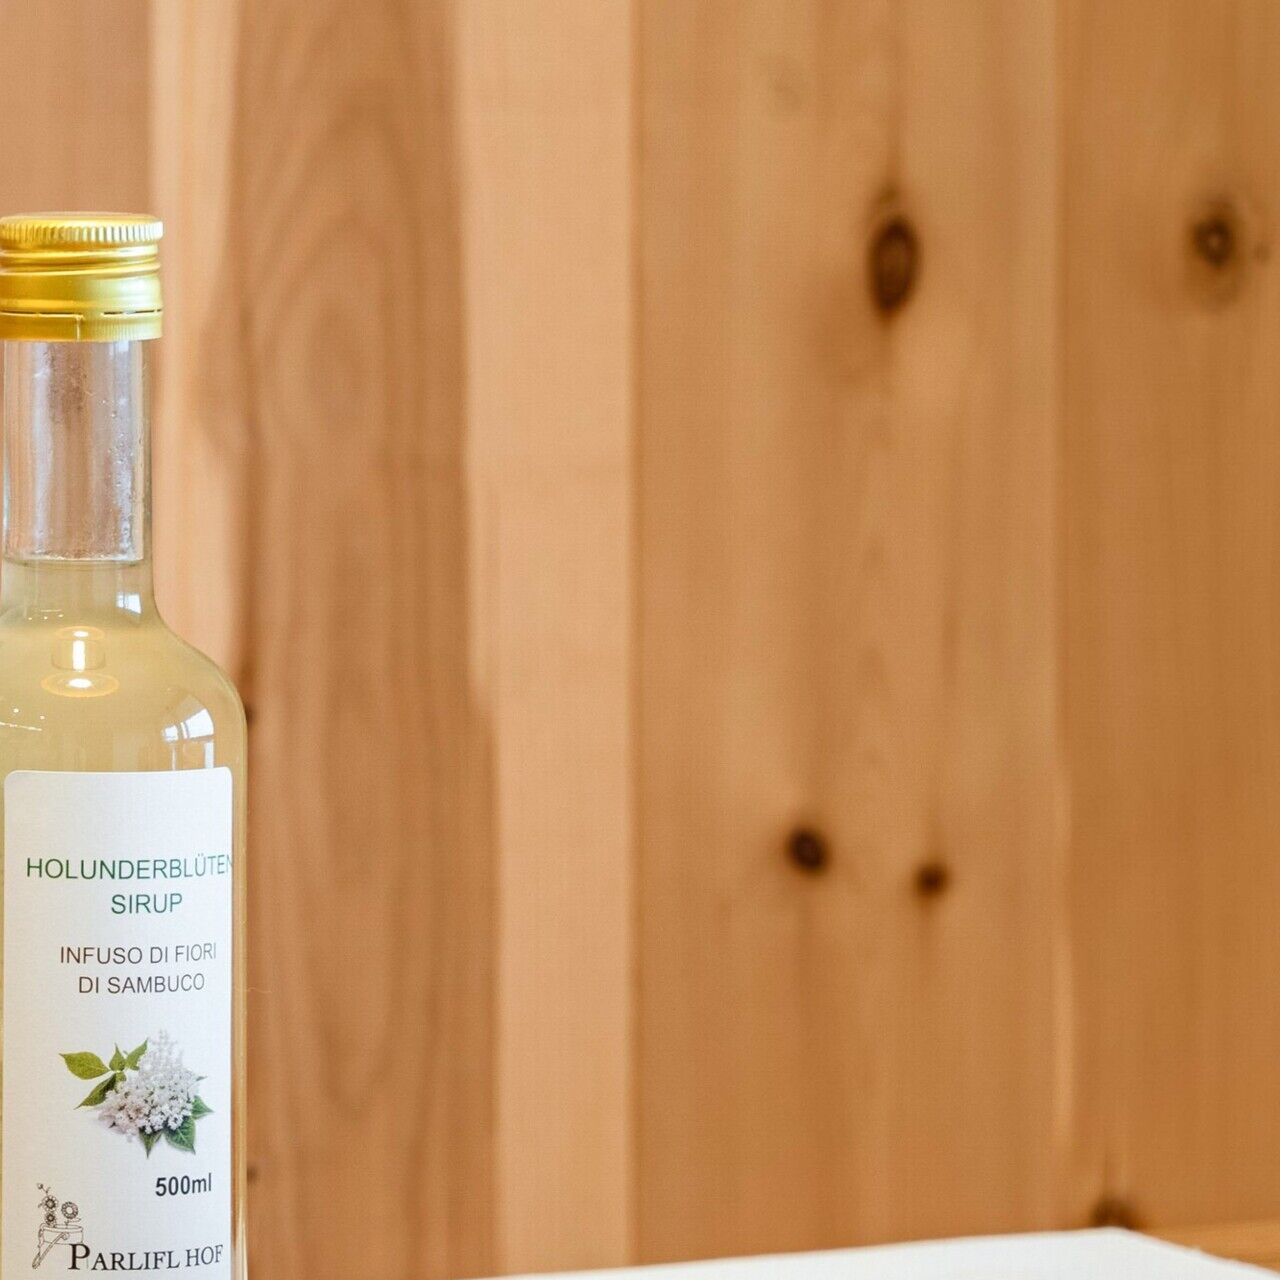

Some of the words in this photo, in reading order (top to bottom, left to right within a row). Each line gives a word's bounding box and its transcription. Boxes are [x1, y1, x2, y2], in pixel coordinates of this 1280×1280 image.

[111, 893, 183, 915] SIRUP
[60, 946, 143, 965] INFUSO
[149, 946, 168, 964] DI
[175, 942, 217, 962] FIORI
[78, 976, 99, 994] DI
[107, 973, 205, 994] SAMBUCO
[155, 1173, 212, 1197] 500ml
[185, 1244, 223, 1267] HOF
